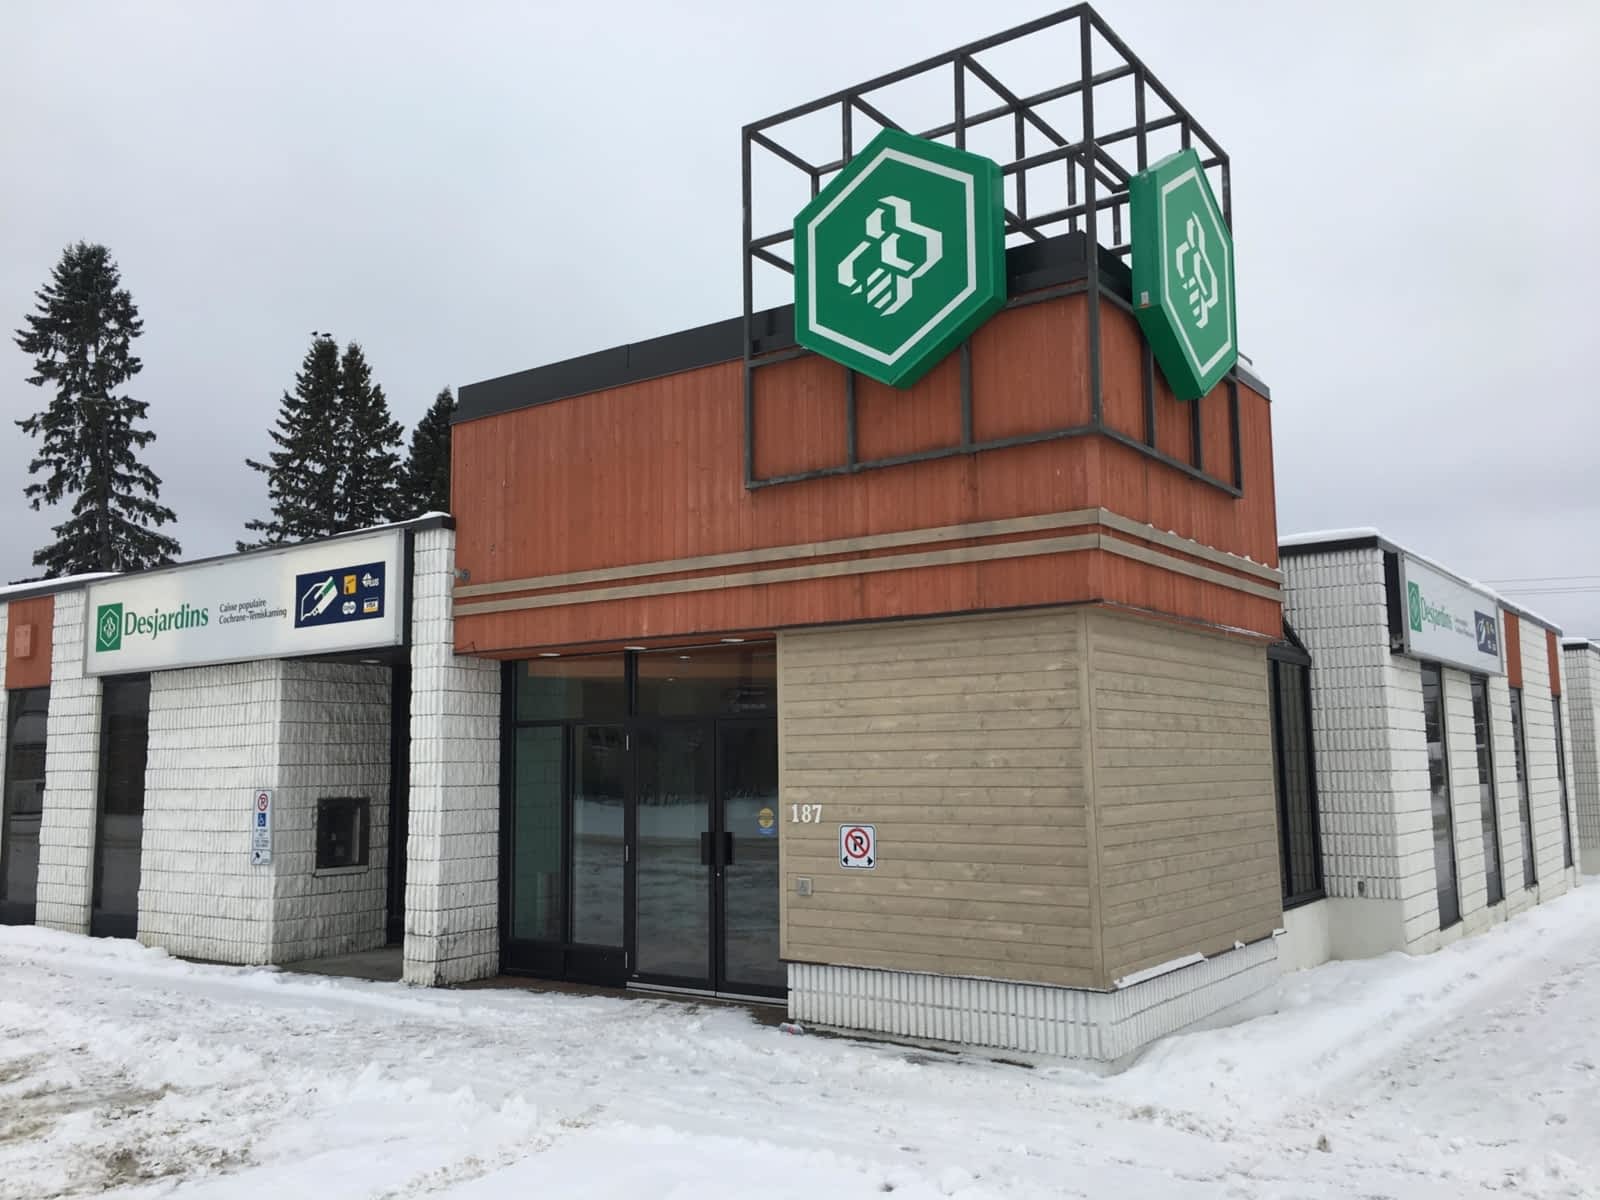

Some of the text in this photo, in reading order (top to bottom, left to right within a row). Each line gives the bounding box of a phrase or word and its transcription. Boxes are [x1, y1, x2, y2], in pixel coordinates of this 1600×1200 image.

[219, 599, 267, 614] Caisse populaire
[123, 603, 209, 640] Desjardins
[791, 803, 823, 824] 187
